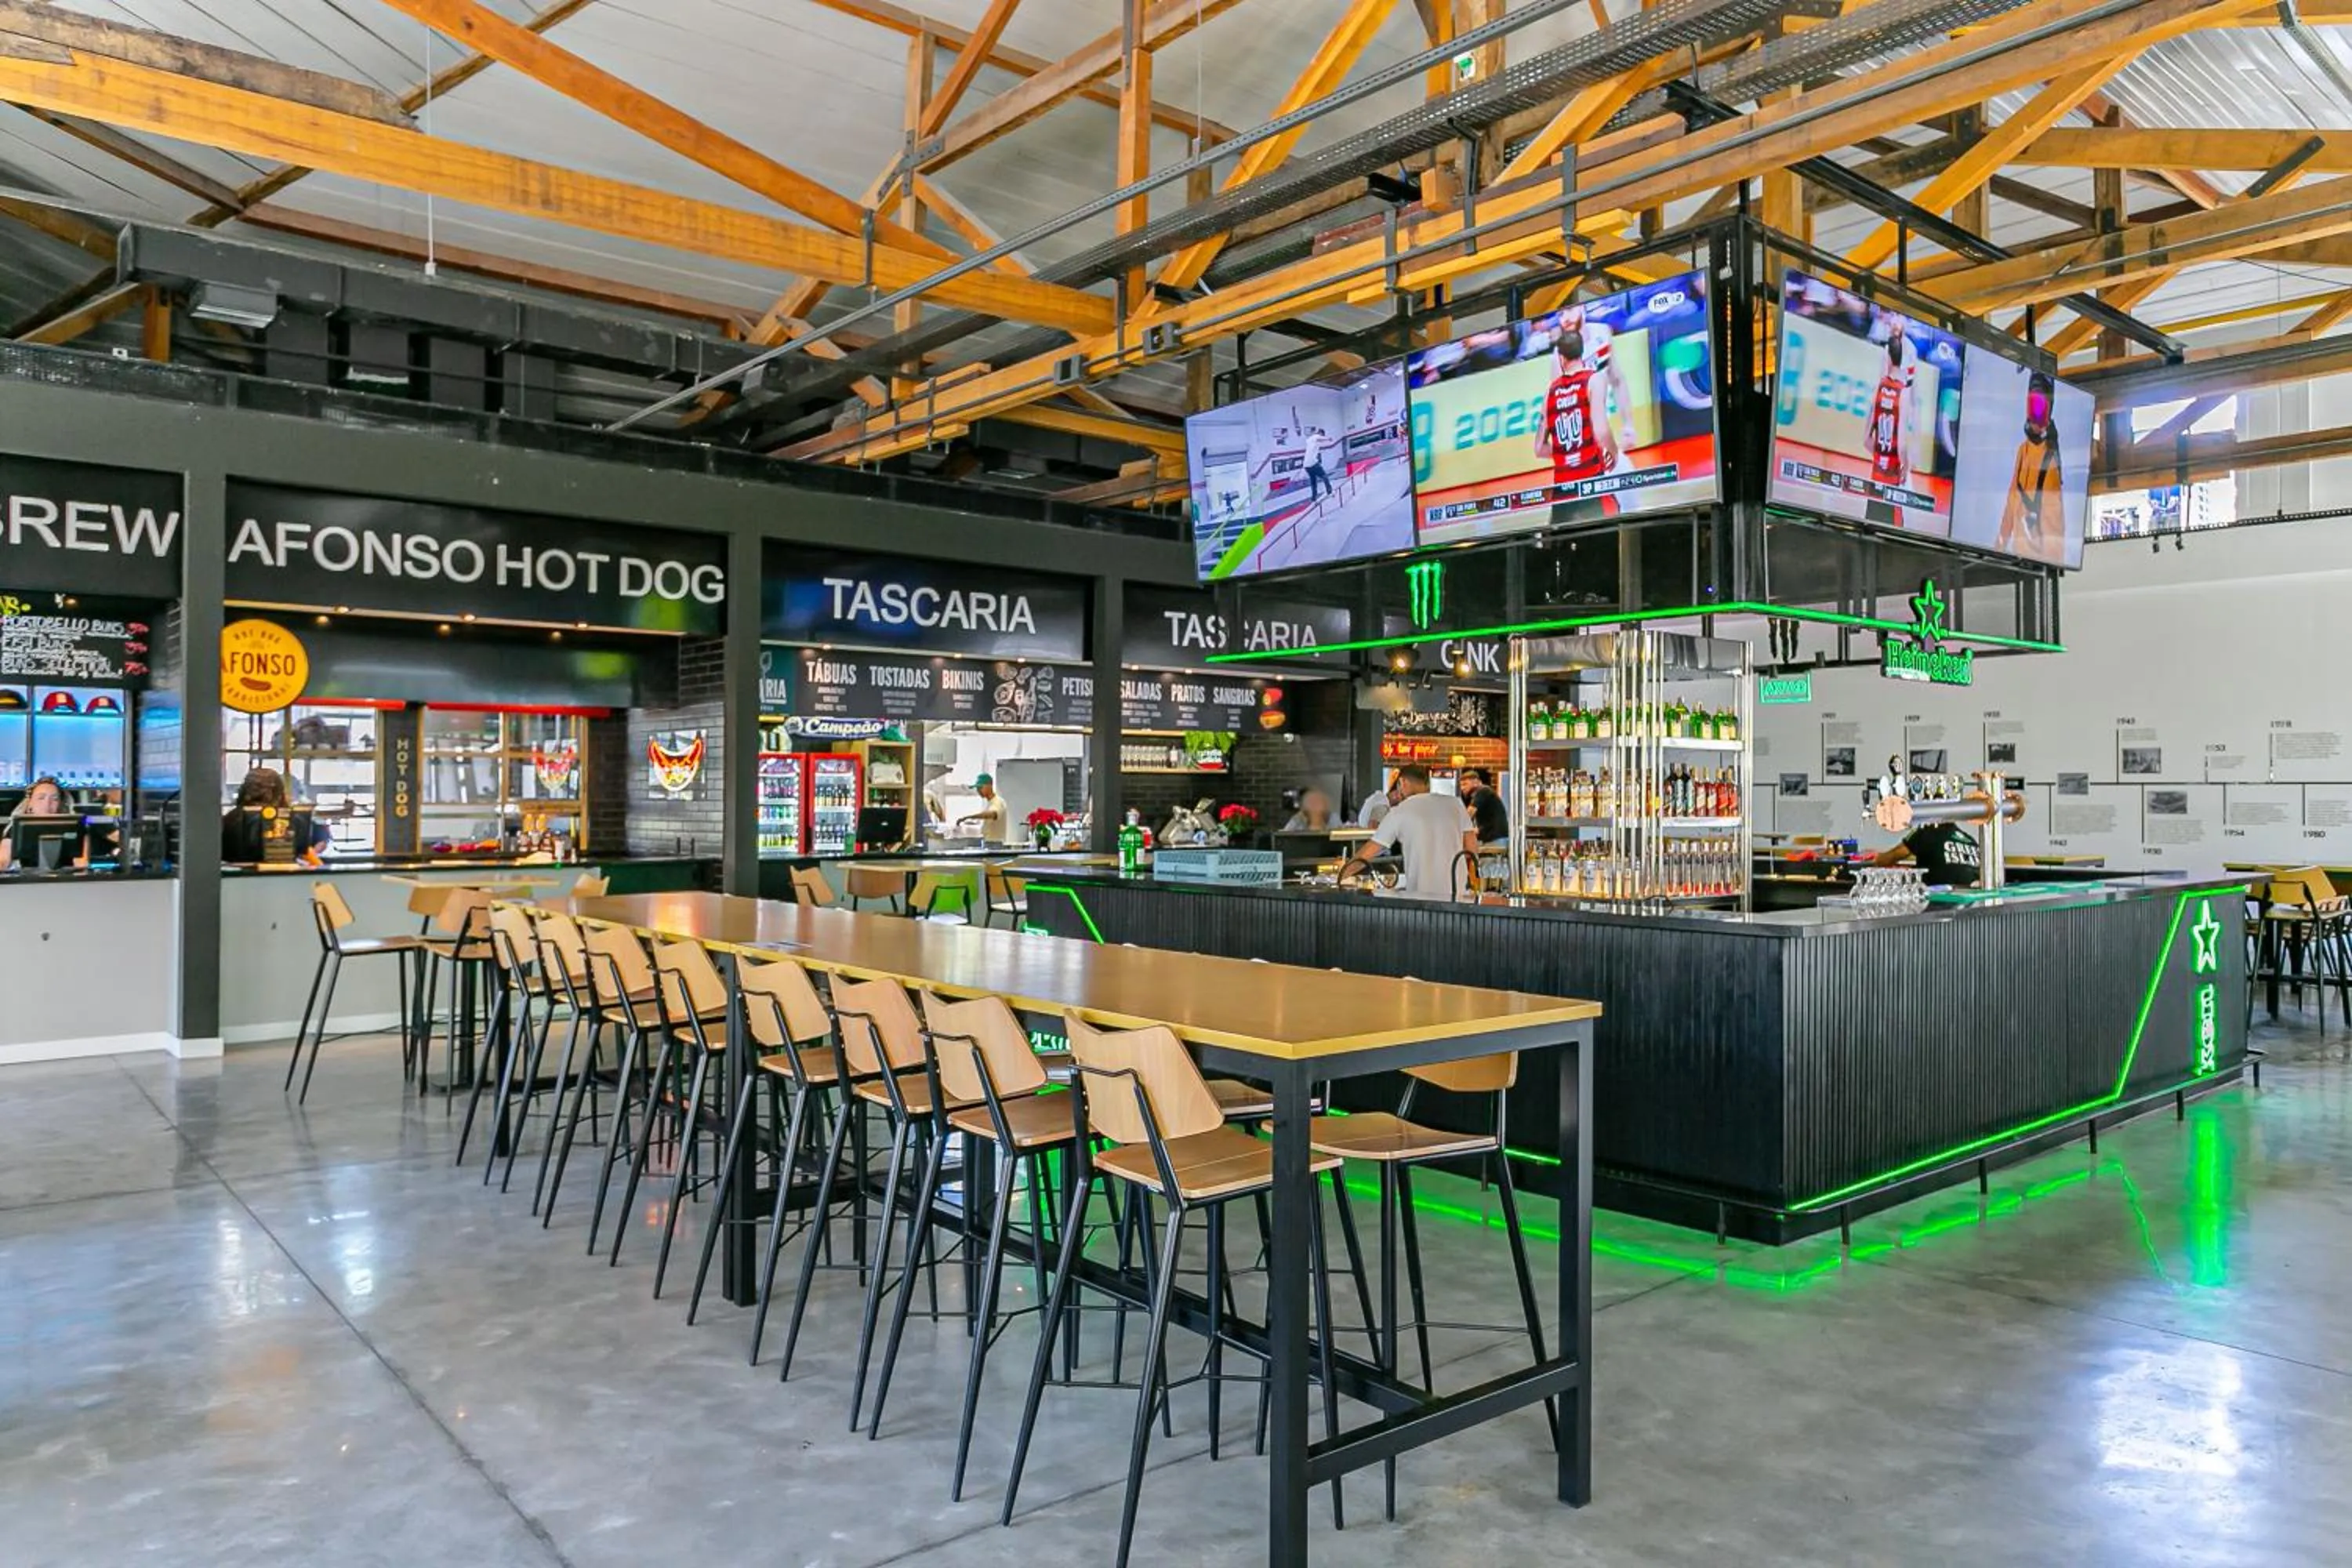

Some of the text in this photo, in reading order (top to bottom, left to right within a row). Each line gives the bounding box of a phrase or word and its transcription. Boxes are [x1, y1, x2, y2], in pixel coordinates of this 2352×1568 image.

[0, 495, 180, 557] REW
[228, 519, 725, 604] AFONSO HOT DOG
[823, 577, 1036, 633] TASCARIA
[1163, 611, 1318, 652] TASARIA
[806, 659, 857, 685] TÁBUAS
[869, 666, 931, 690] TOSTADAS
[942, 669, 985, 691] BIKINIS
[1171, 684, 1205, 703] PRATOS
[1213, 687, 1256, 706] SANGRIAS
[395, 739, 409, 818] HOT DOG
